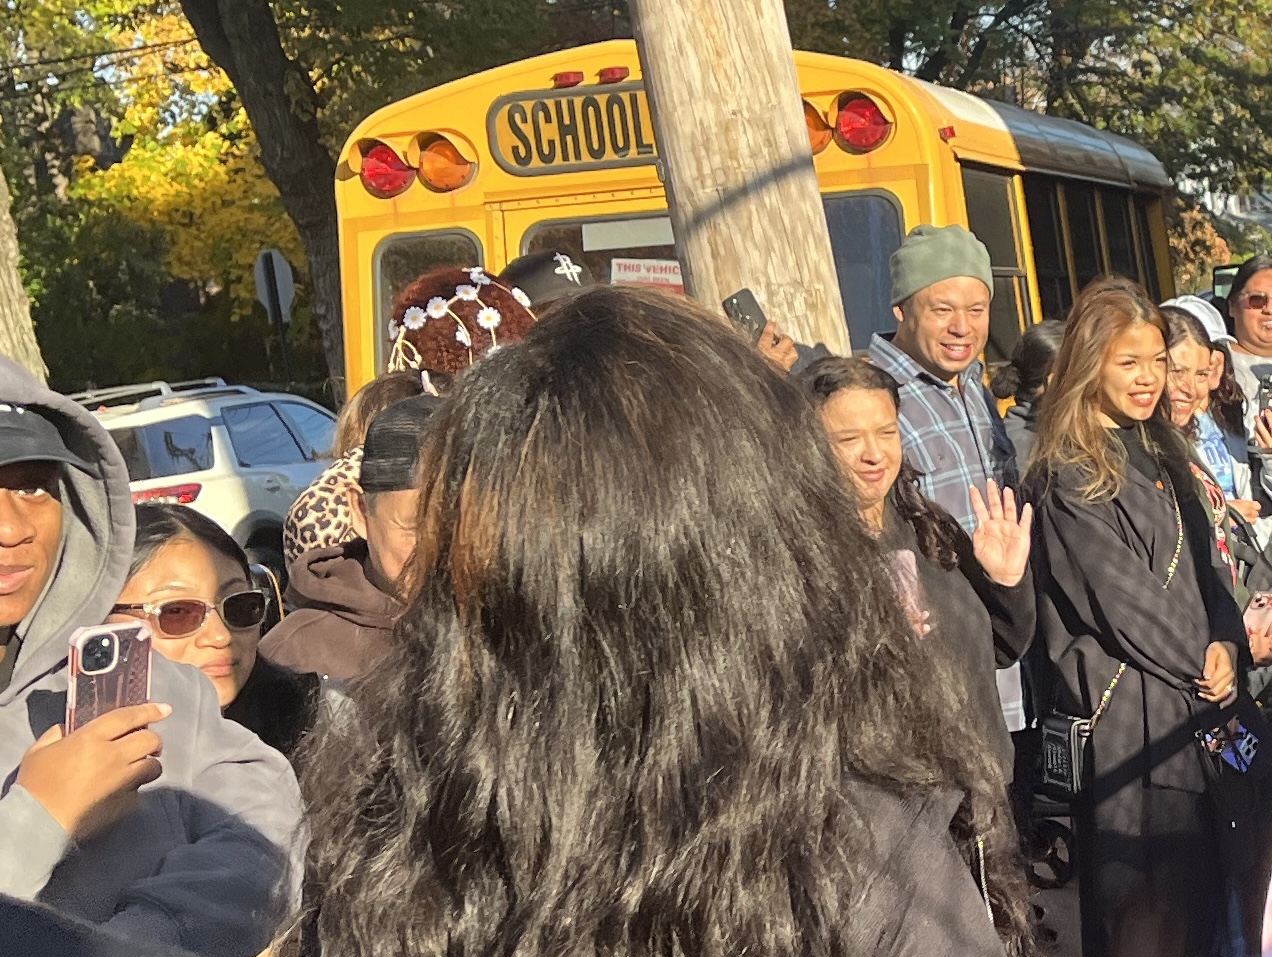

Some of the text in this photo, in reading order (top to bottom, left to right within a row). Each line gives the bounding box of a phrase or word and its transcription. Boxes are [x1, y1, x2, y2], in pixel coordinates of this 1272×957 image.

[507, 93, 653, 166] SCHOOL
[616, 263, 679, 274] THIS VEHIC
